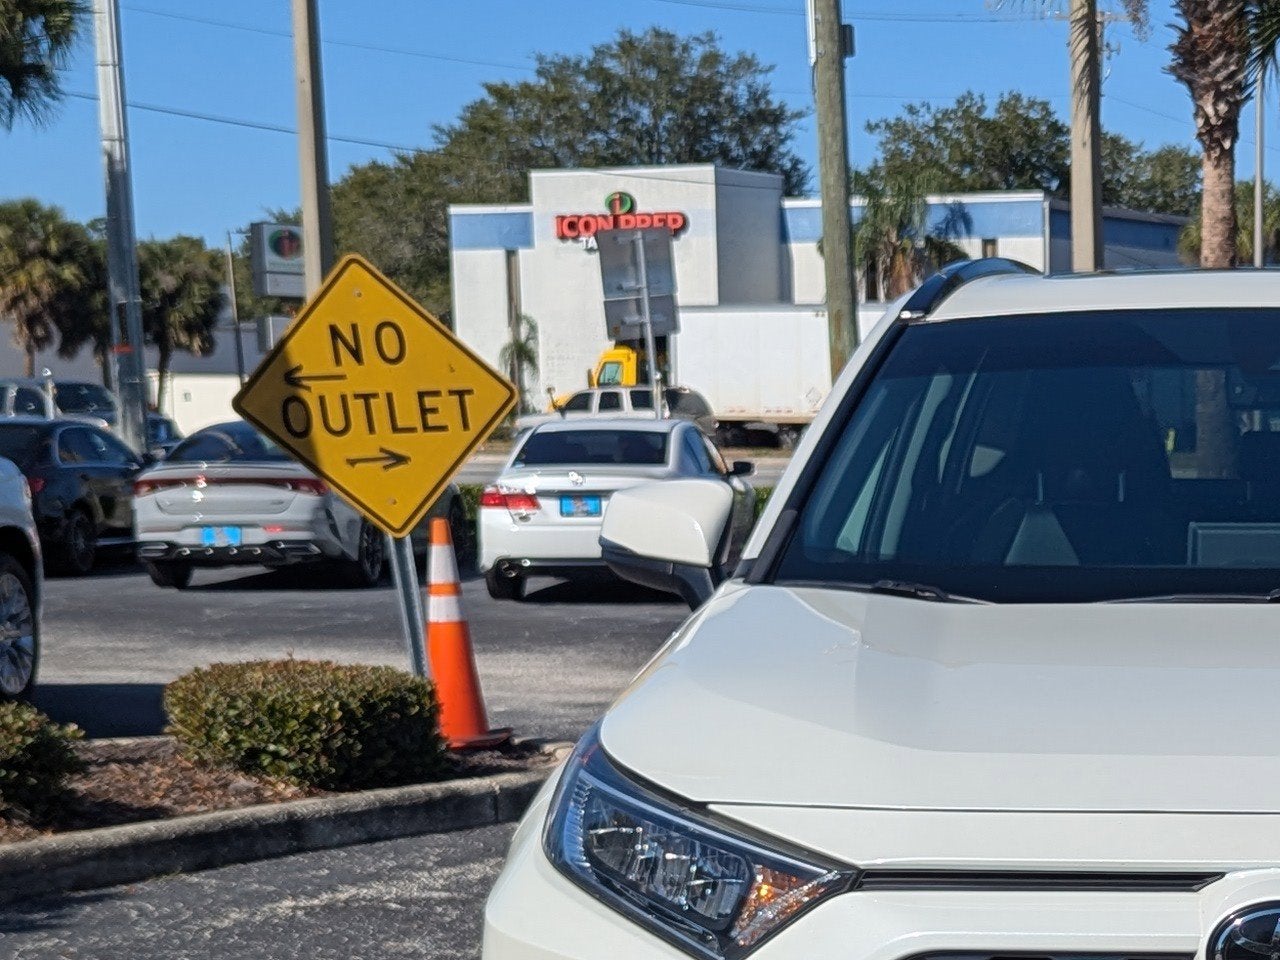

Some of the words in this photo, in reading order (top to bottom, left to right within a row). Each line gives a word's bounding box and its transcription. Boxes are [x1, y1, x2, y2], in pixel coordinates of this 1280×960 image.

[555, 214, 614, 238] ICON
[328, 320, 407, 367] NO
[282, 388, 475, 439] OUTLET
